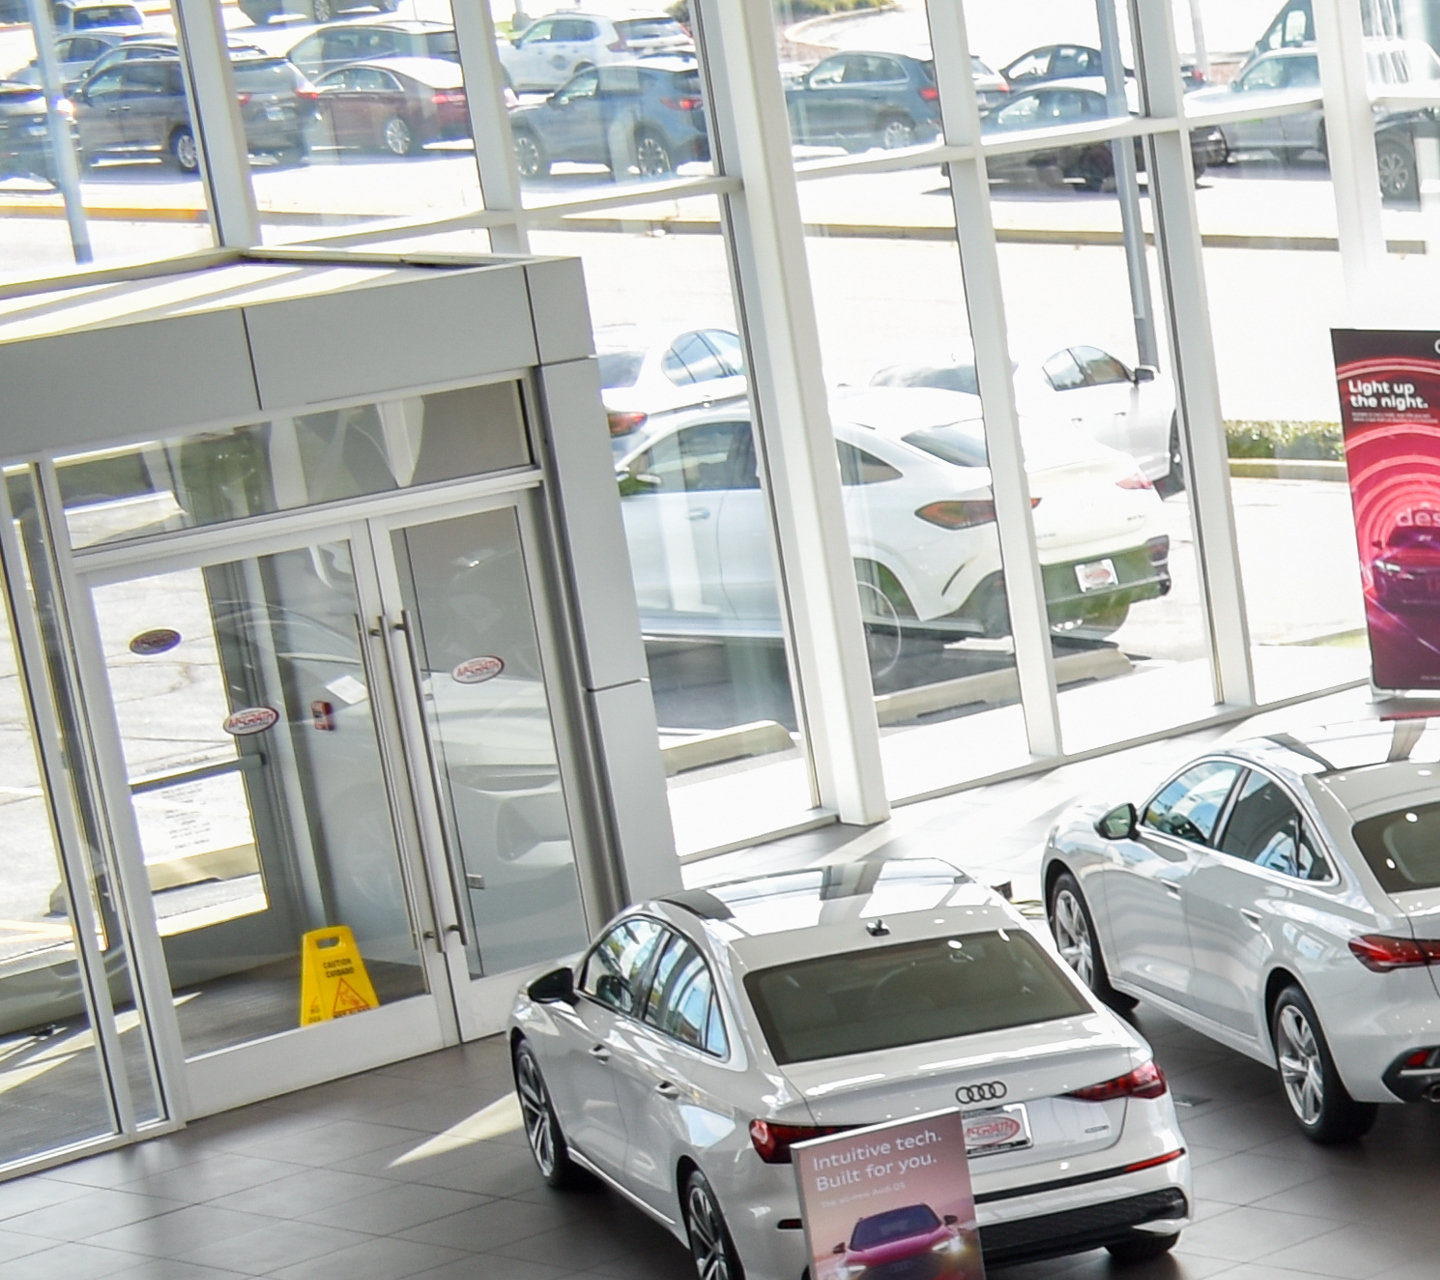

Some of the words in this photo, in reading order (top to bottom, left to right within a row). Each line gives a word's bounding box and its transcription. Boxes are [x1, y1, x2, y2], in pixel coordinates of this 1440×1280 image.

[1348, 380, 1390, 396] Light
[1393, 383, 1415, 398] up
[1350, 394, 1378, 408] the
[1381, 395, 1429, 411] night.
[813, 1143, 891, 1171] Intuitive
[895, 1129, 942, 1151] tech.
[816, 1168, 860, 1192] Built
[865, 1162, 894, 1179] for
[898, 1153, 937, 1175] you.
